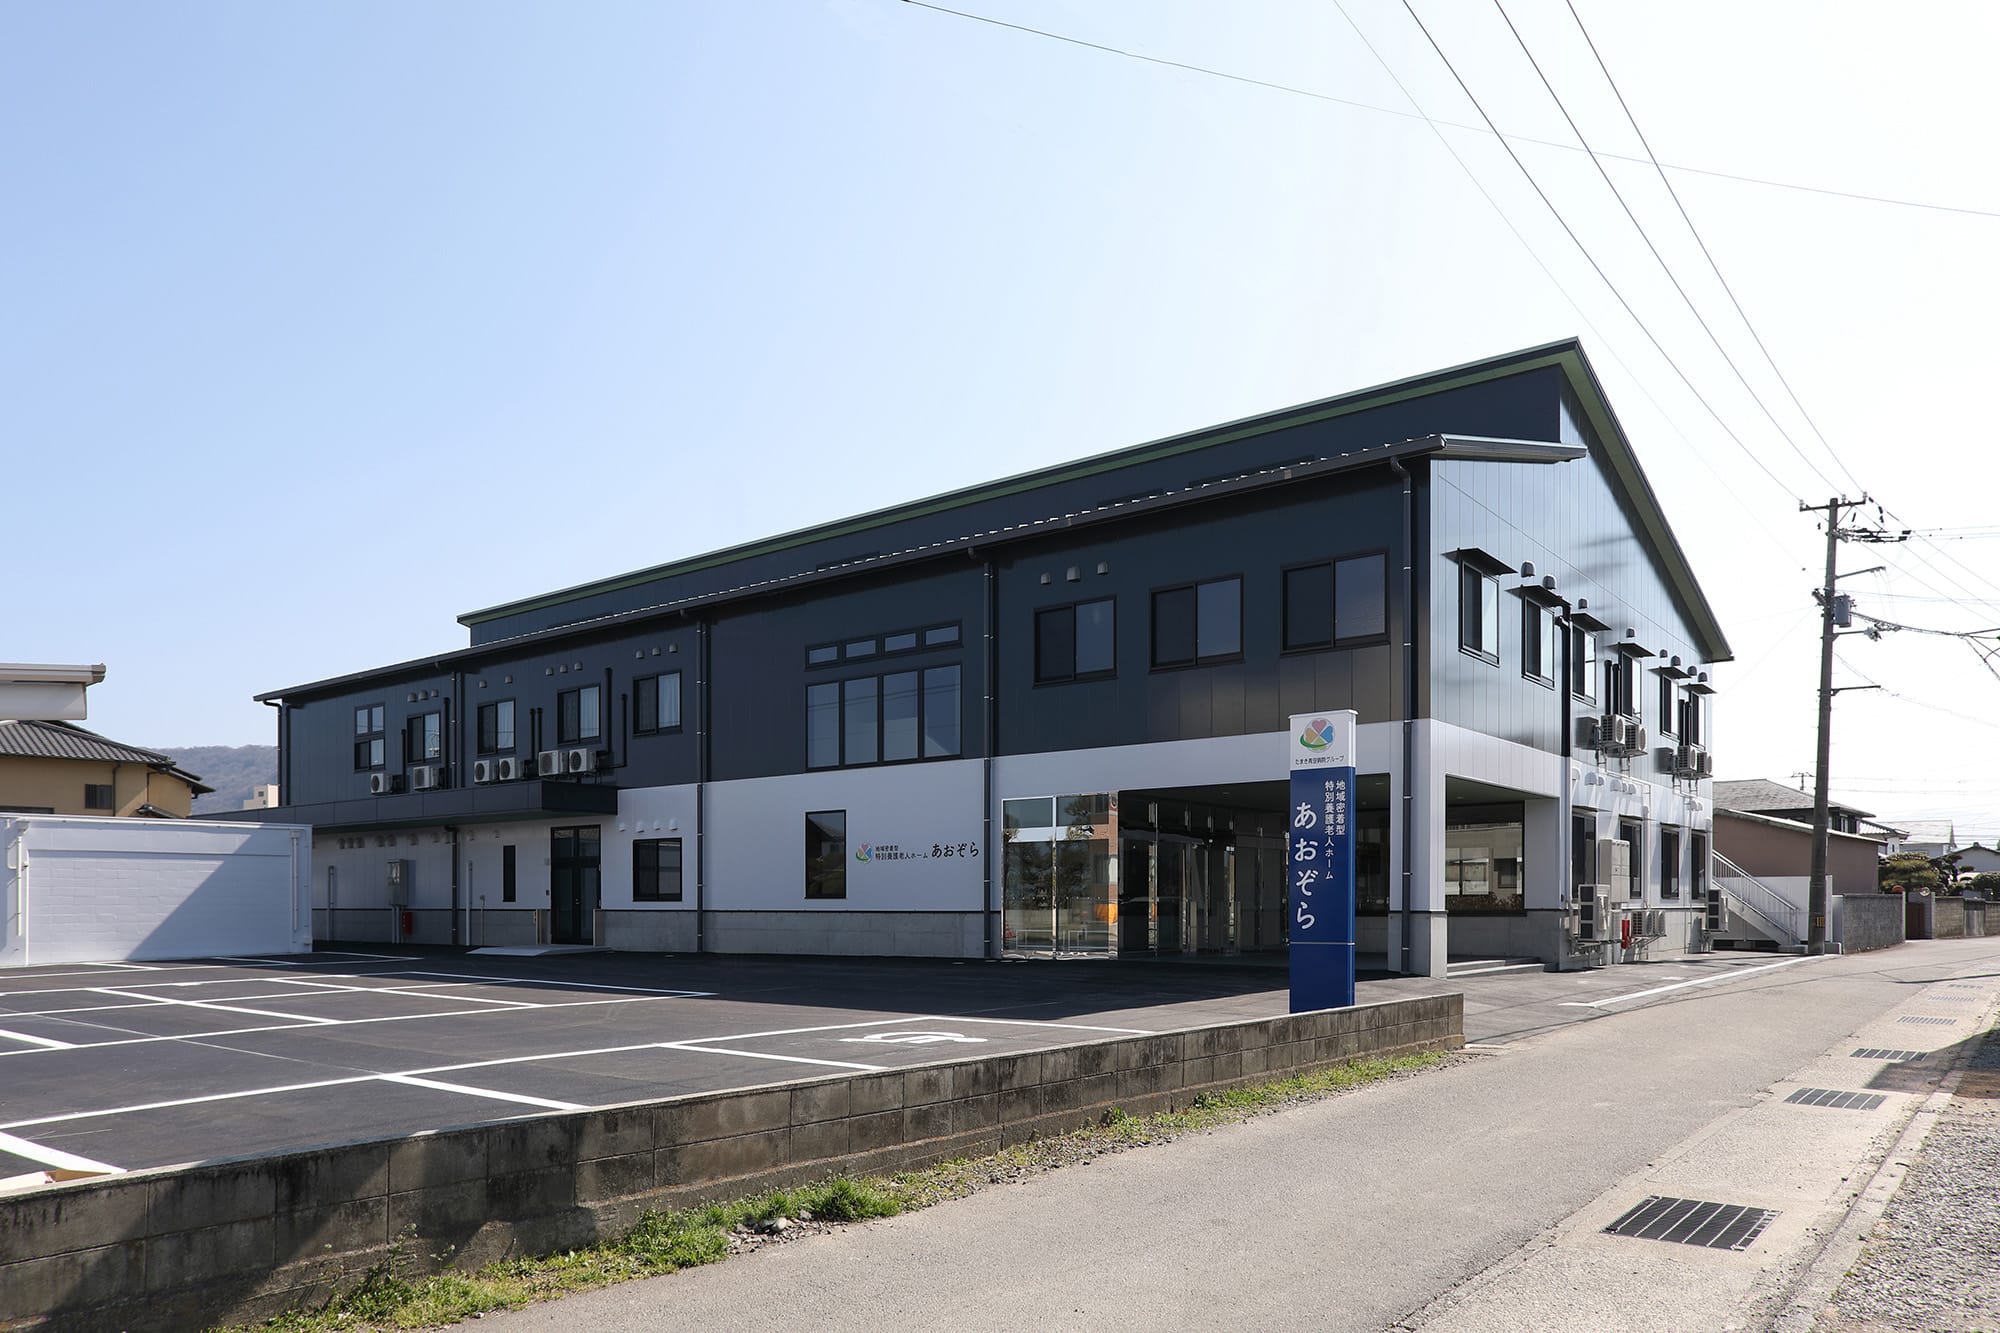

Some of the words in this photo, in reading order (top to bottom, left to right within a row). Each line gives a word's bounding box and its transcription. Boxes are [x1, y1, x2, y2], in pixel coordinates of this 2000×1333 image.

[1324, 780, 1334, 880] 特別養護老人ホーム
[1335, 780, 1345, 835] 地域密着型
[931, 841, 980, 858] あおぞら
[1294, 802, 1319, 930] あおぞら
